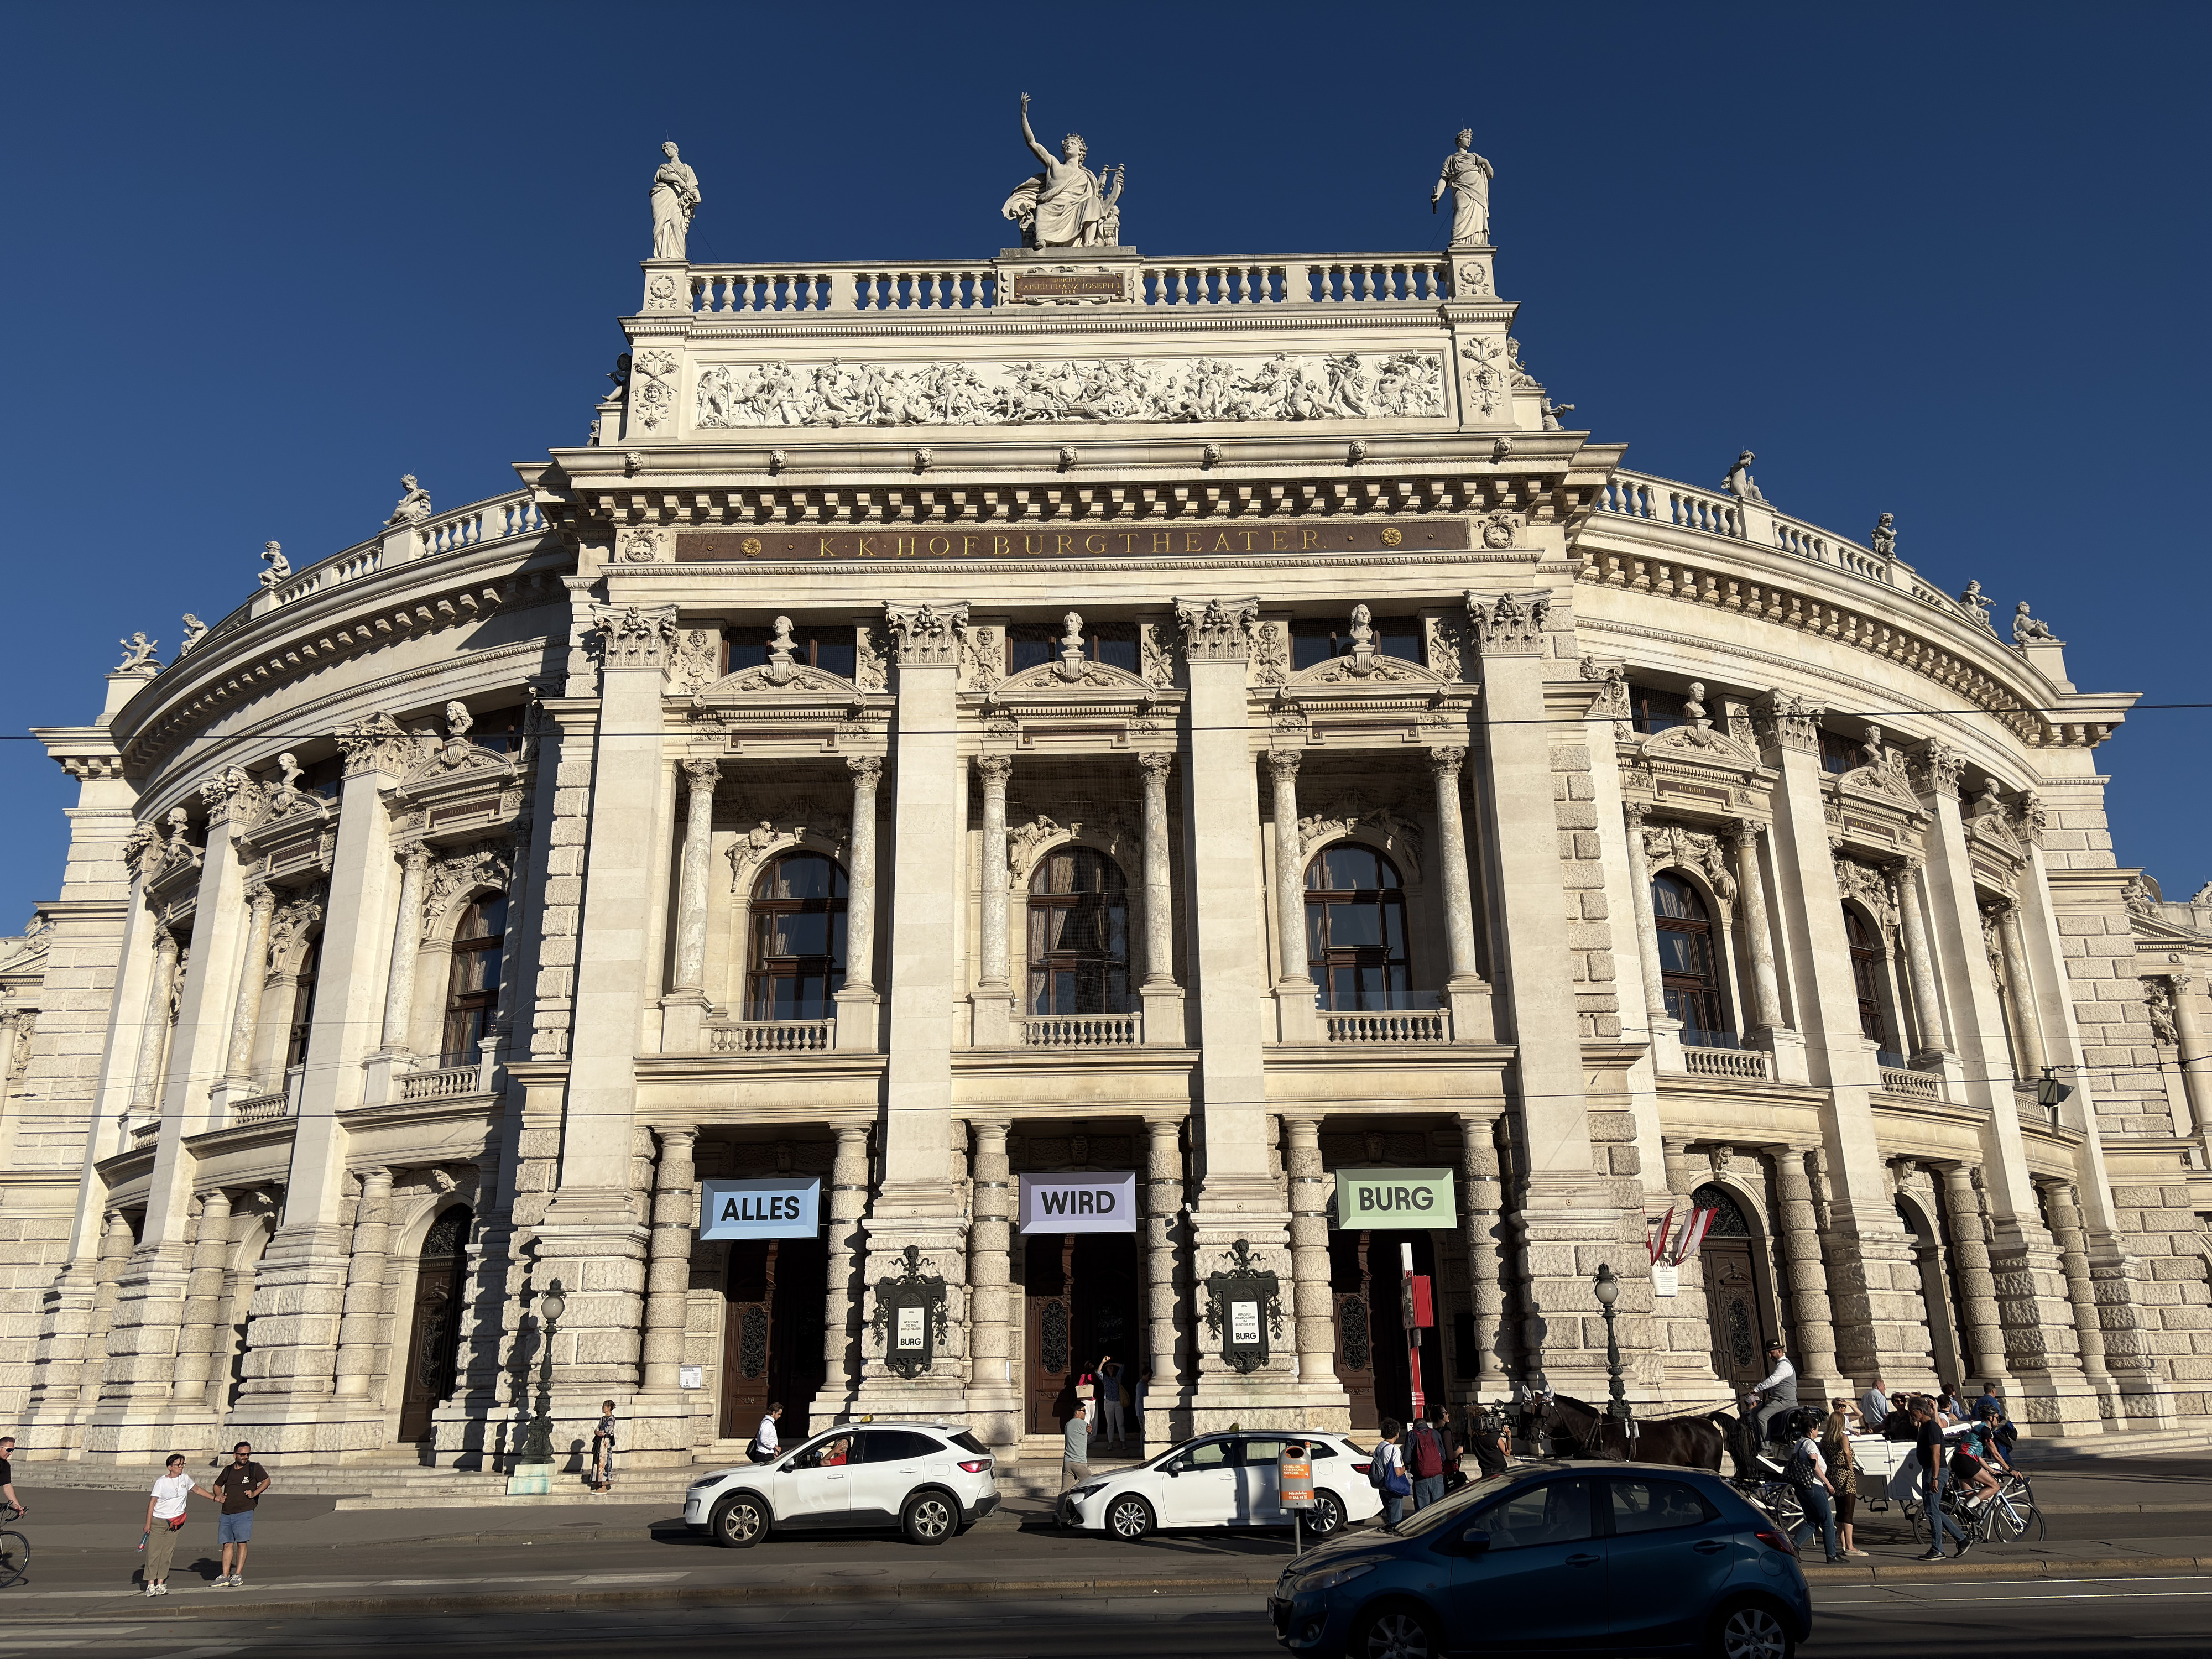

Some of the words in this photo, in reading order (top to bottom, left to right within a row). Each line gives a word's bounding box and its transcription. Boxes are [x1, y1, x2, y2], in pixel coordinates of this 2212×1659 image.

[1679, 785, 1708, 795] HEBBEL
[721, 1196, 800, 1221] ALLES
[1041, 1191, 1115, 1214] WIRD
[1359, 1186, 1434, 1211] BURG
